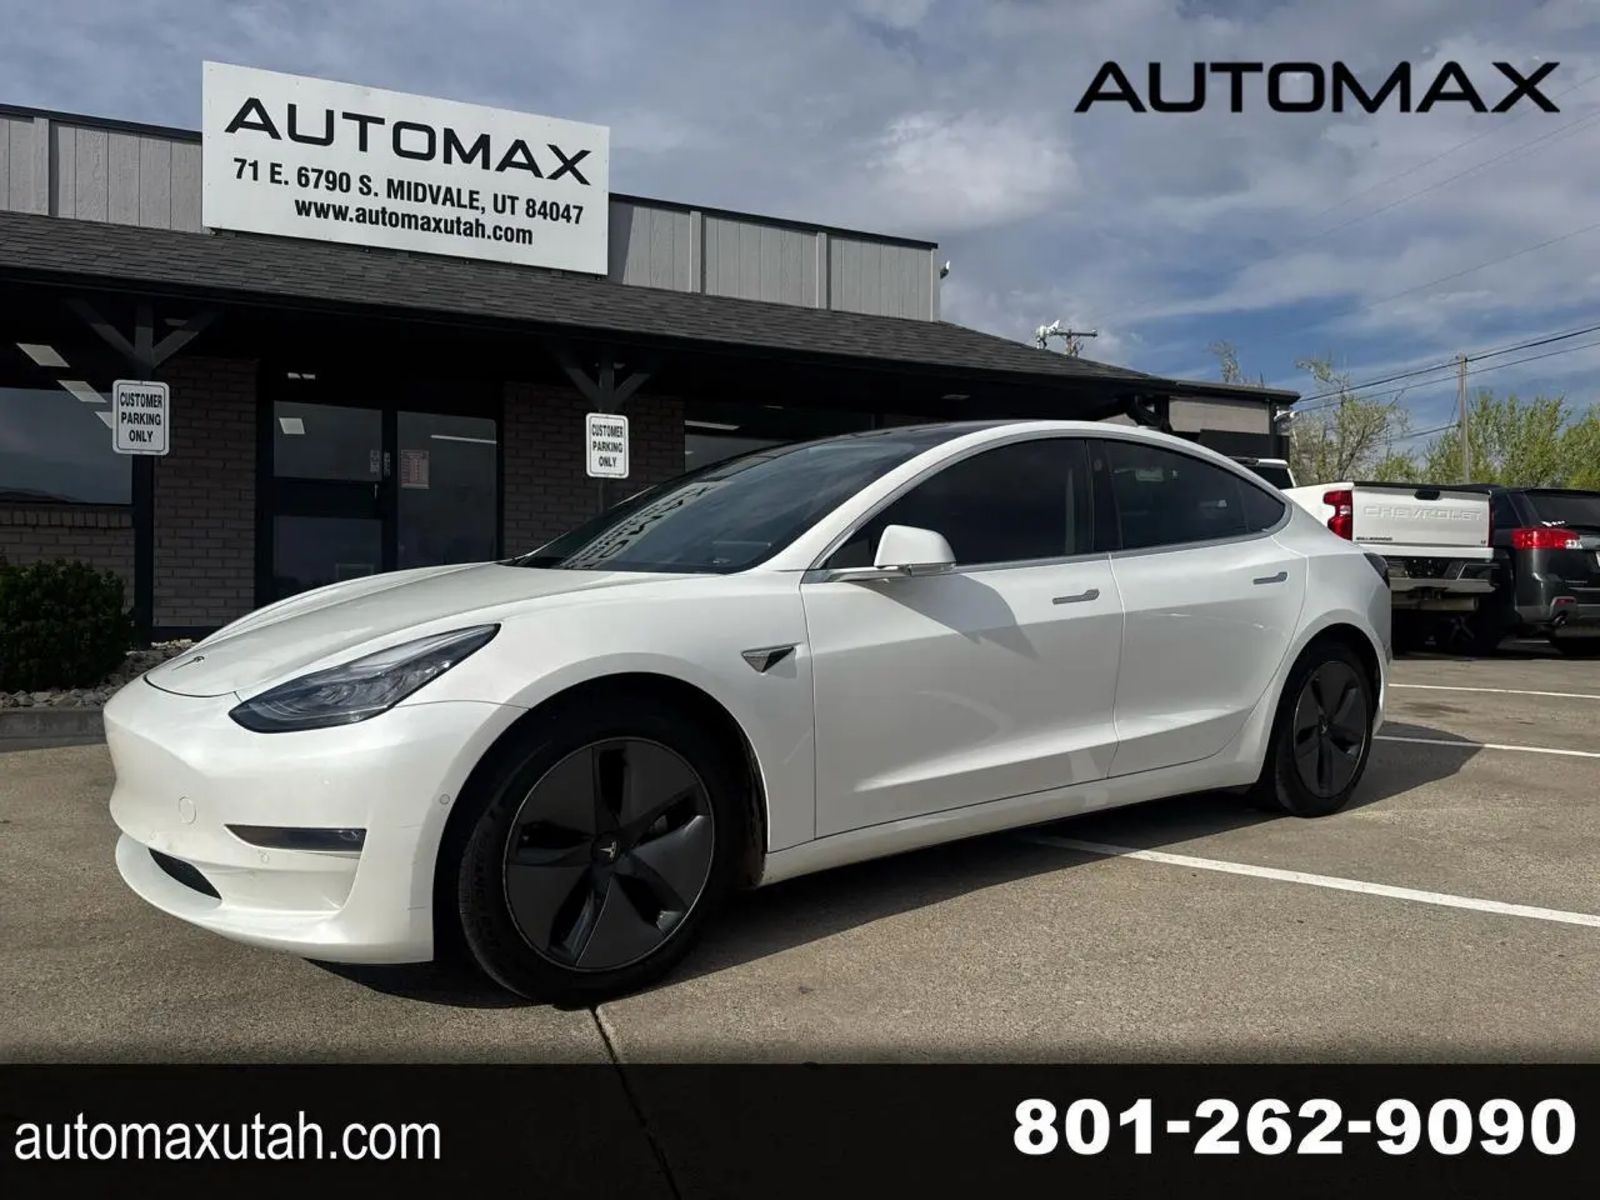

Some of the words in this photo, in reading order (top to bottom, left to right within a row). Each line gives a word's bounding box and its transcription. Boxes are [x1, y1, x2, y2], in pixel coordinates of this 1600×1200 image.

[224, 97, 592, 186] AUTOMAX
[234, 157, 258, 181] 71
[270, 163, 289, 185] E.
[297, 166, 351, 193] 6790
[358, 174, 378, 197] S.
[387, 178, 486, 215] MIDVALE,
[493, 193, 519, 215] UT
[525, 198, 583, 225] 84047
[295, 199, 533, 245] www.automaxutah.com
[120, 392, 163, 409] CUSTOMER
[121, 412, 161, 425] PARKING
[129, 429, 153, 442] ONLY
[592, 424, 623, 438] CUSTOMER
[592, 441, 623, 453] PARKING
[599, 456, 617, 467] ONLY
[1363, 504, 1483, 521] CHEVROLET
